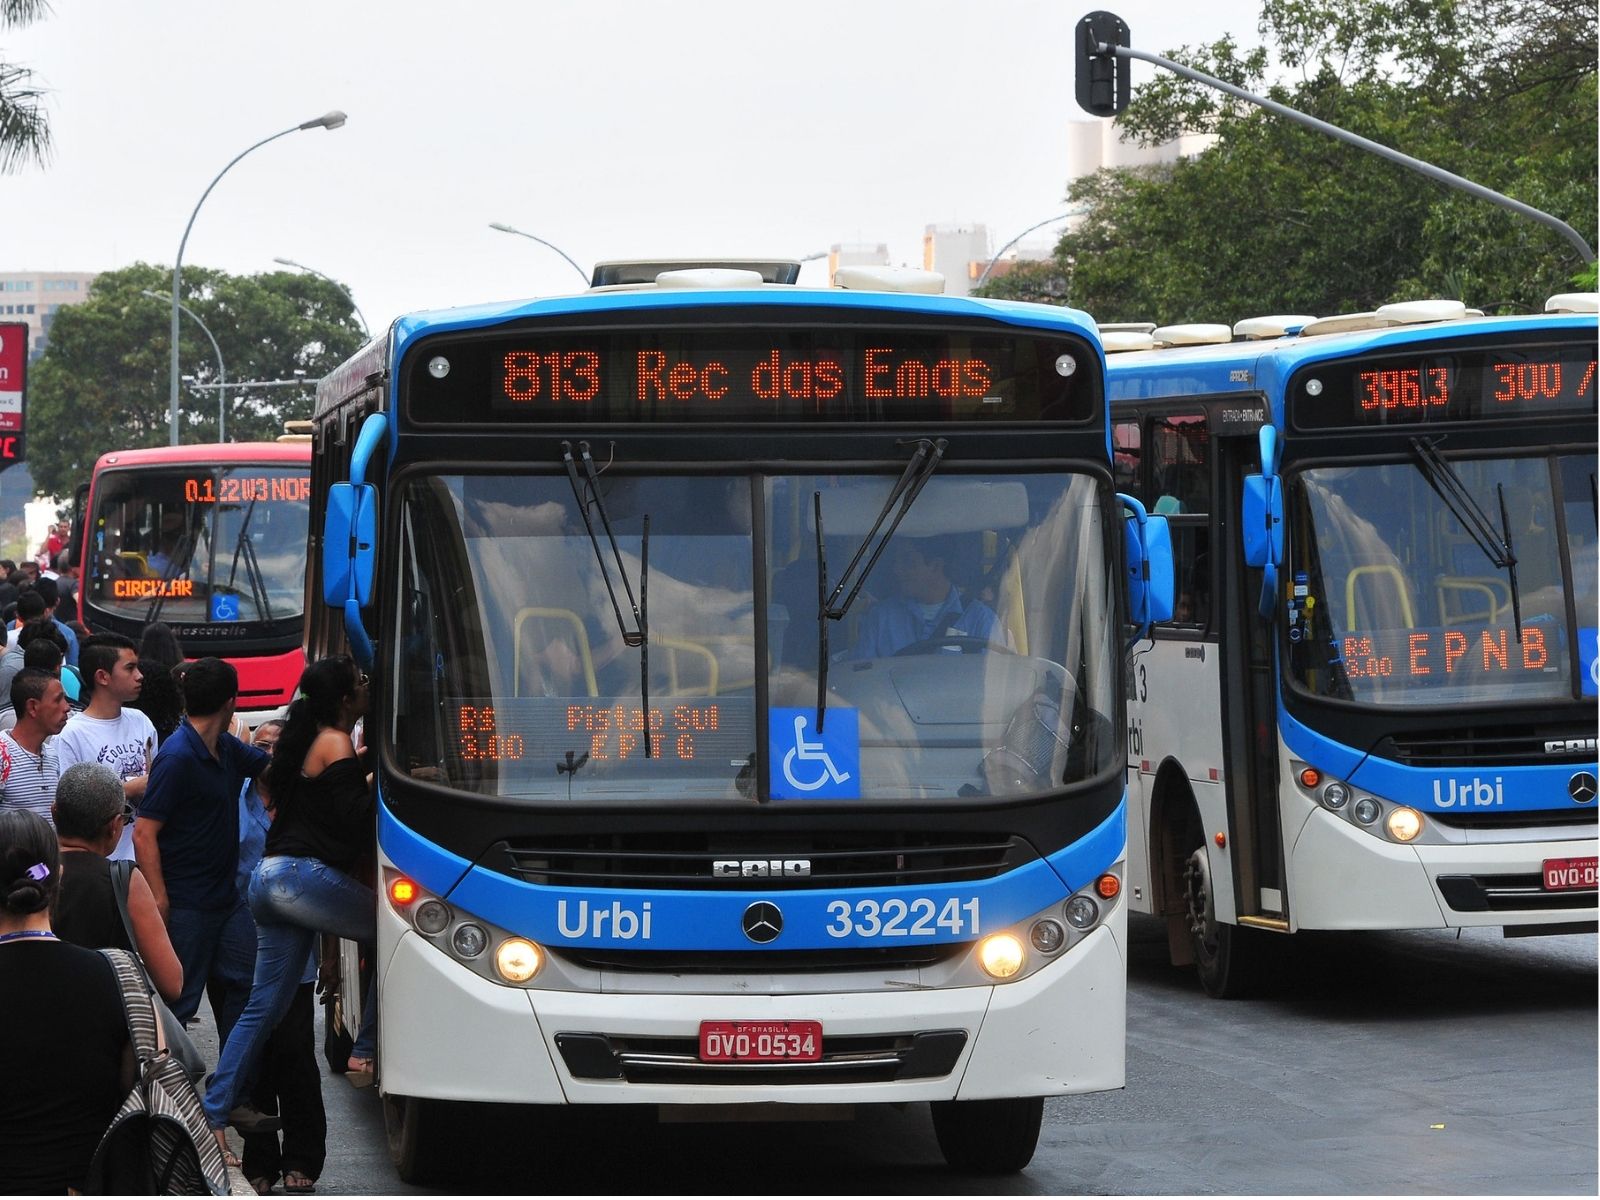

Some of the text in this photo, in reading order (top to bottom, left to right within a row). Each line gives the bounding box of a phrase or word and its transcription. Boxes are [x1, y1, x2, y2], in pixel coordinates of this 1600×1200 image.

[502, 347, 993, 401] 813 Rec das Emas
[1360, 367, 1448, 409] 396.3
[1494, 362, 1561, 401] 300
[242, 478, 268, 501] W3
[114, 579, 193, 597] CIRCULAR
[1344, 635, 1371, 656] R$
[1140, 664, 1147, 703] 3
[460, 705, 496, 731] R$
[673, 703, 720, 731] Sul
[1129, 718, 1144, 756] rbi
[1544, 738, 1598, 754] CAI
[1433, 776, 1503, 808] Urbi
[713, 859, 811, 878] CAIO
[556, 900, 652, 940] Urbi
[826, 898, 981, 938] 332241
